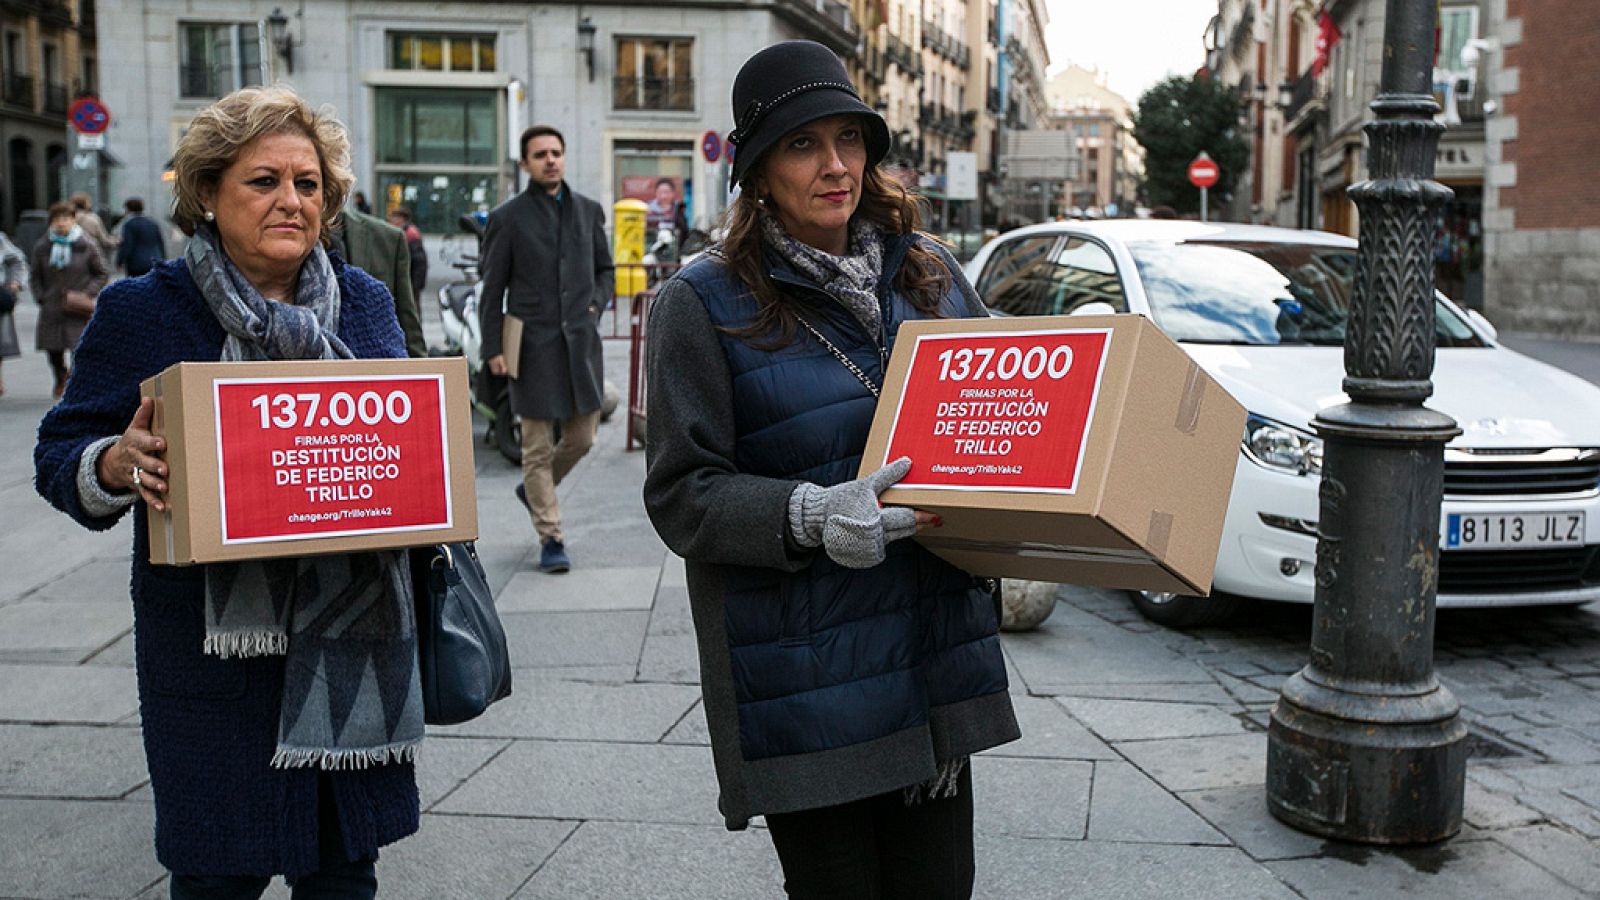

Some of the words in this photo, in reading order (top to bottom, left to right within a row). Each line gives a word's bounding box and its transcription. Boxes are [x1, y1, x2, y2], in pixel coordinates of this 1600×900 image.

[938, 344, 1074, 381] 137.000
[959, 388, 997, 398] FIRMAS
[997, 388, 1019, 398] POR
[1020, 388, 1034, 398] LA
[252, 390, 412, 429] 137.000
[935, 398, 1050, 418] DESTITUCIÓN
[933, 419, 957, 436] DE
[958, 419, 1042, 436] FEDERICO
[294, 434, 338, 446] FIRMAS
[340, 433, 363, 445] POR
[365, 432, 380, 443] LA
[953, 438, 1012, 456] TRILLO
[271, 442, 401, 467] DESTITUCIÓN
[275, 469, 302, 486] DE
[306, 463, 400, 484] FEDERICO
[305, 484, 373, 503] TRILLO
[288, 506, 393, 523] change.org/TrilloYak42
[1462, 517, 1525, 543] 8113
[1537, 516, 1580, 542] JLZ
